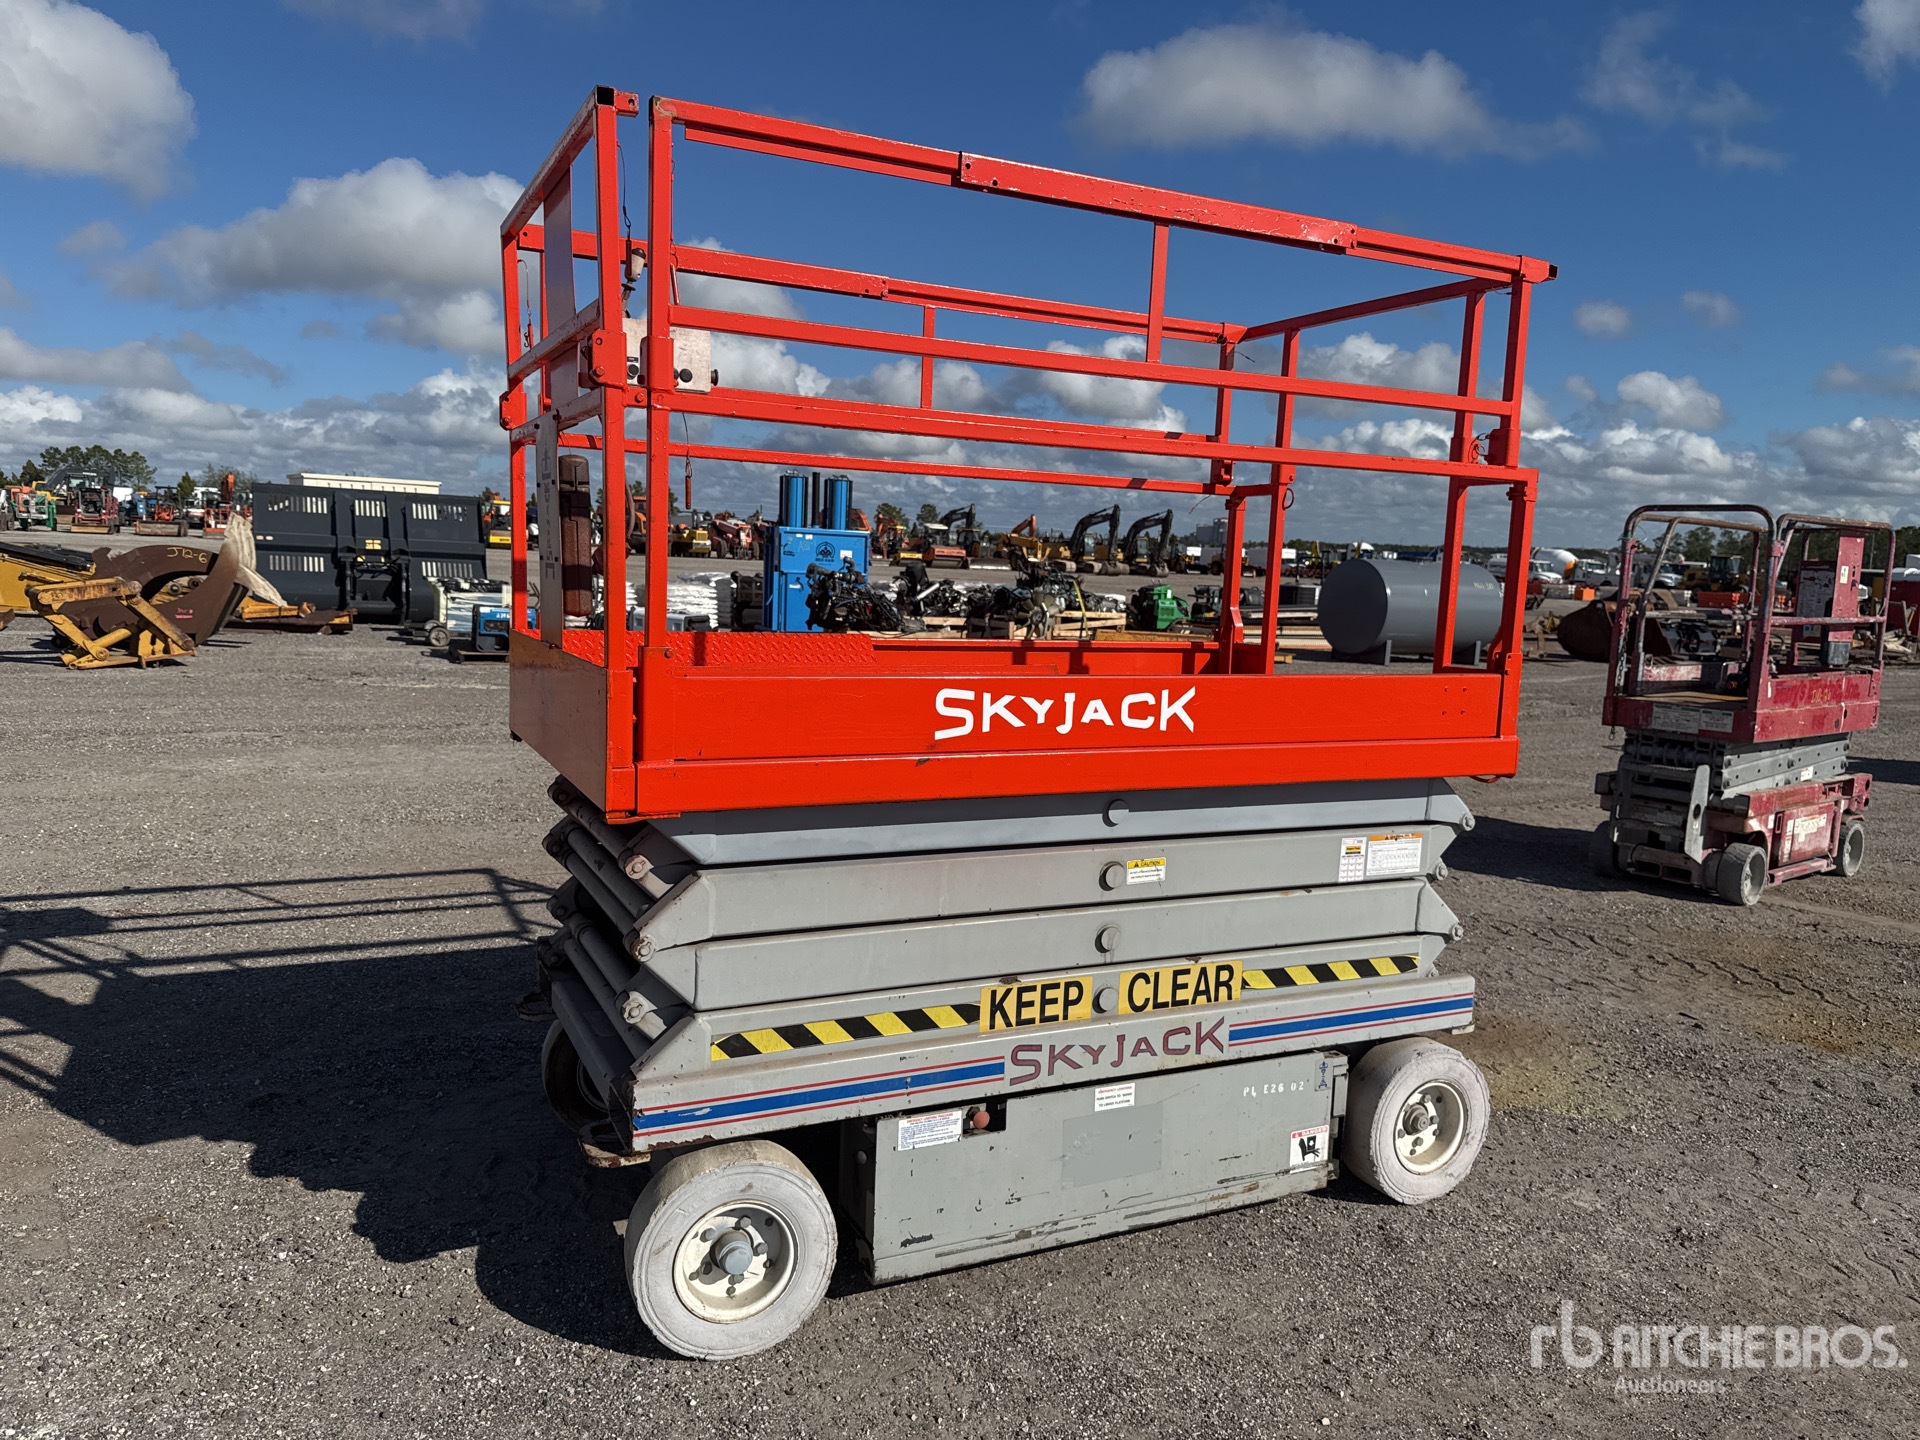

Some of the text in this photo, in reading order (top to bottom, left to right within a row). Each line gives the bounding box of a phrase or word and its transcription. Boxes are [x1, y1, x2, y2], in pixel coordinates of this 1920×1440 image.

[167, 547, 208, 564] J12-6
[934, 686, 1196, 740] SKYJACK
[988, 964, 1235, 1030] KEEP CLEAR
[1009, 1016, 1225, 1086] SKYJACK
[1263, 1083, 1284, 1094] E26
